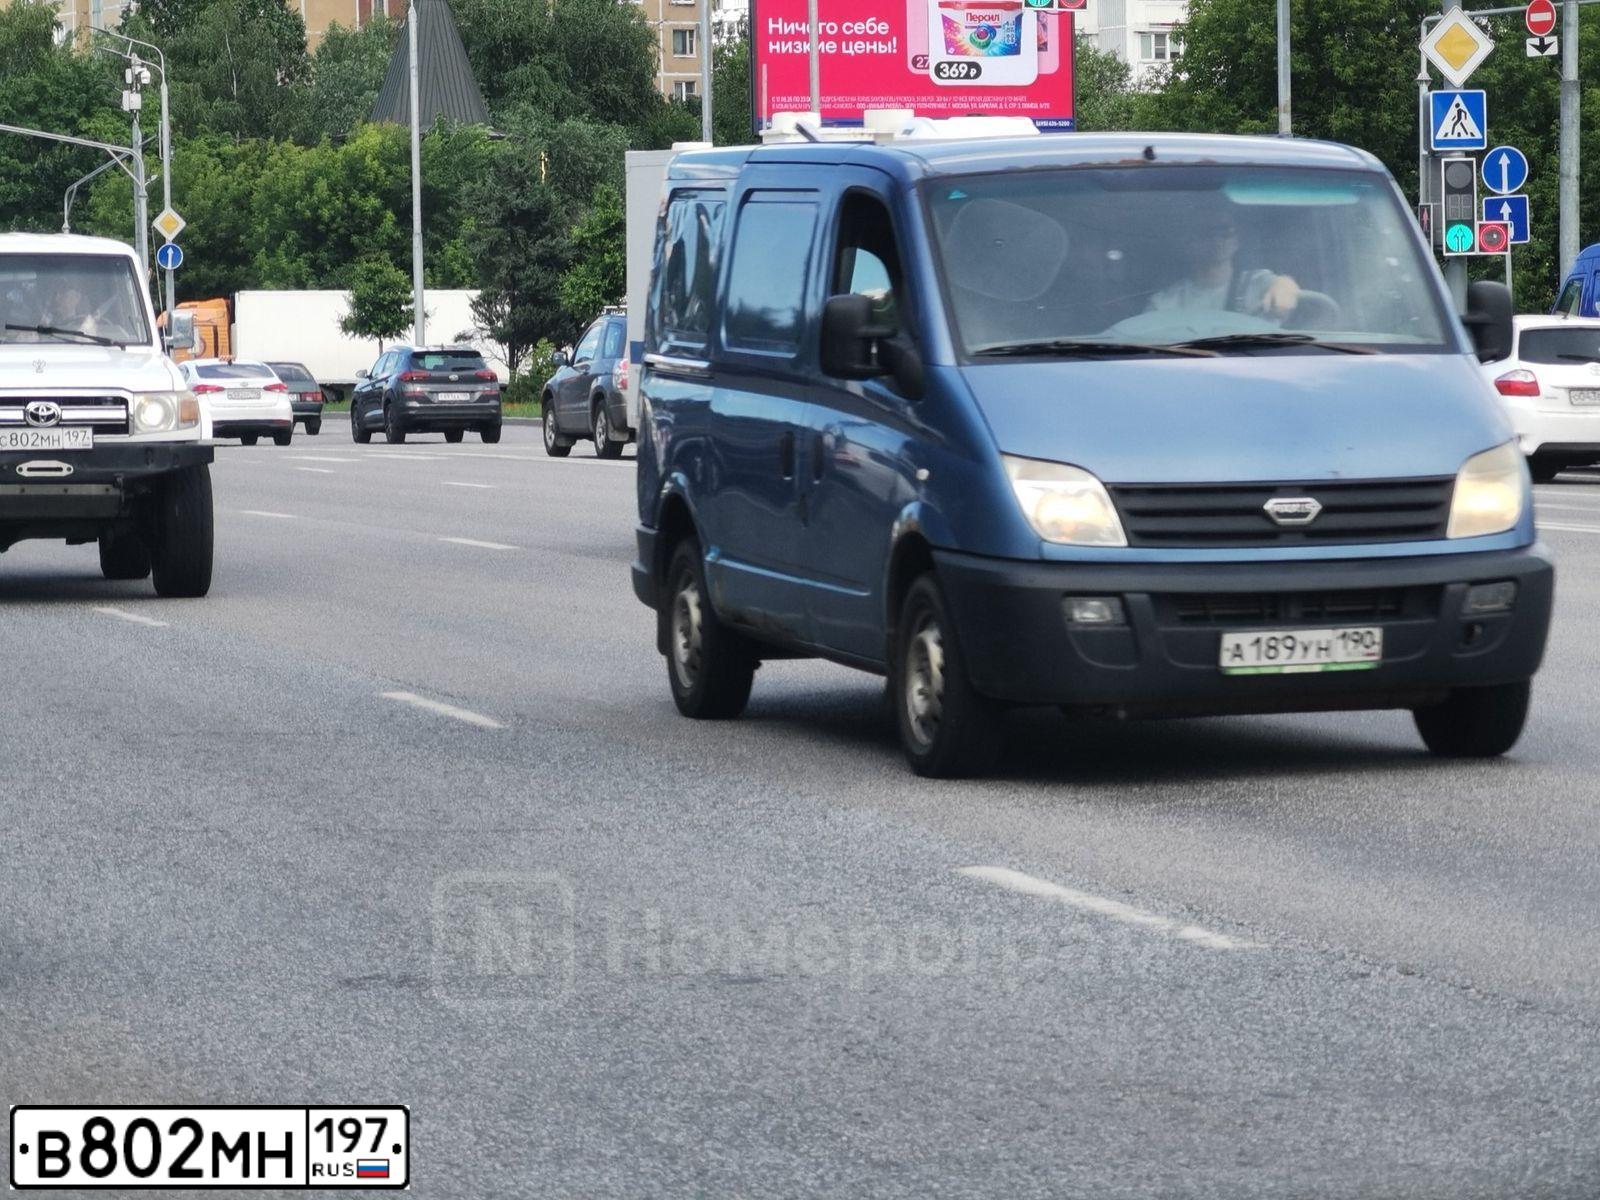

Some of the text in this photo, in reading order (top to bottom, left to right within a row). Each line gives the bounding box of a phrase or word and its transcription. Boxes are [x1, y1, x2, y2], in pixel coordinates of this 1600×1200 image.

[841, 17, 889, 34] себе
[965, 12, 1000, 23] Персил
[841, 37, 897, 55] цены!
[939, 63, 968, 78] 369
[65, 430, 88, 442] 197
[1336, 630, 1377, 650] 190
